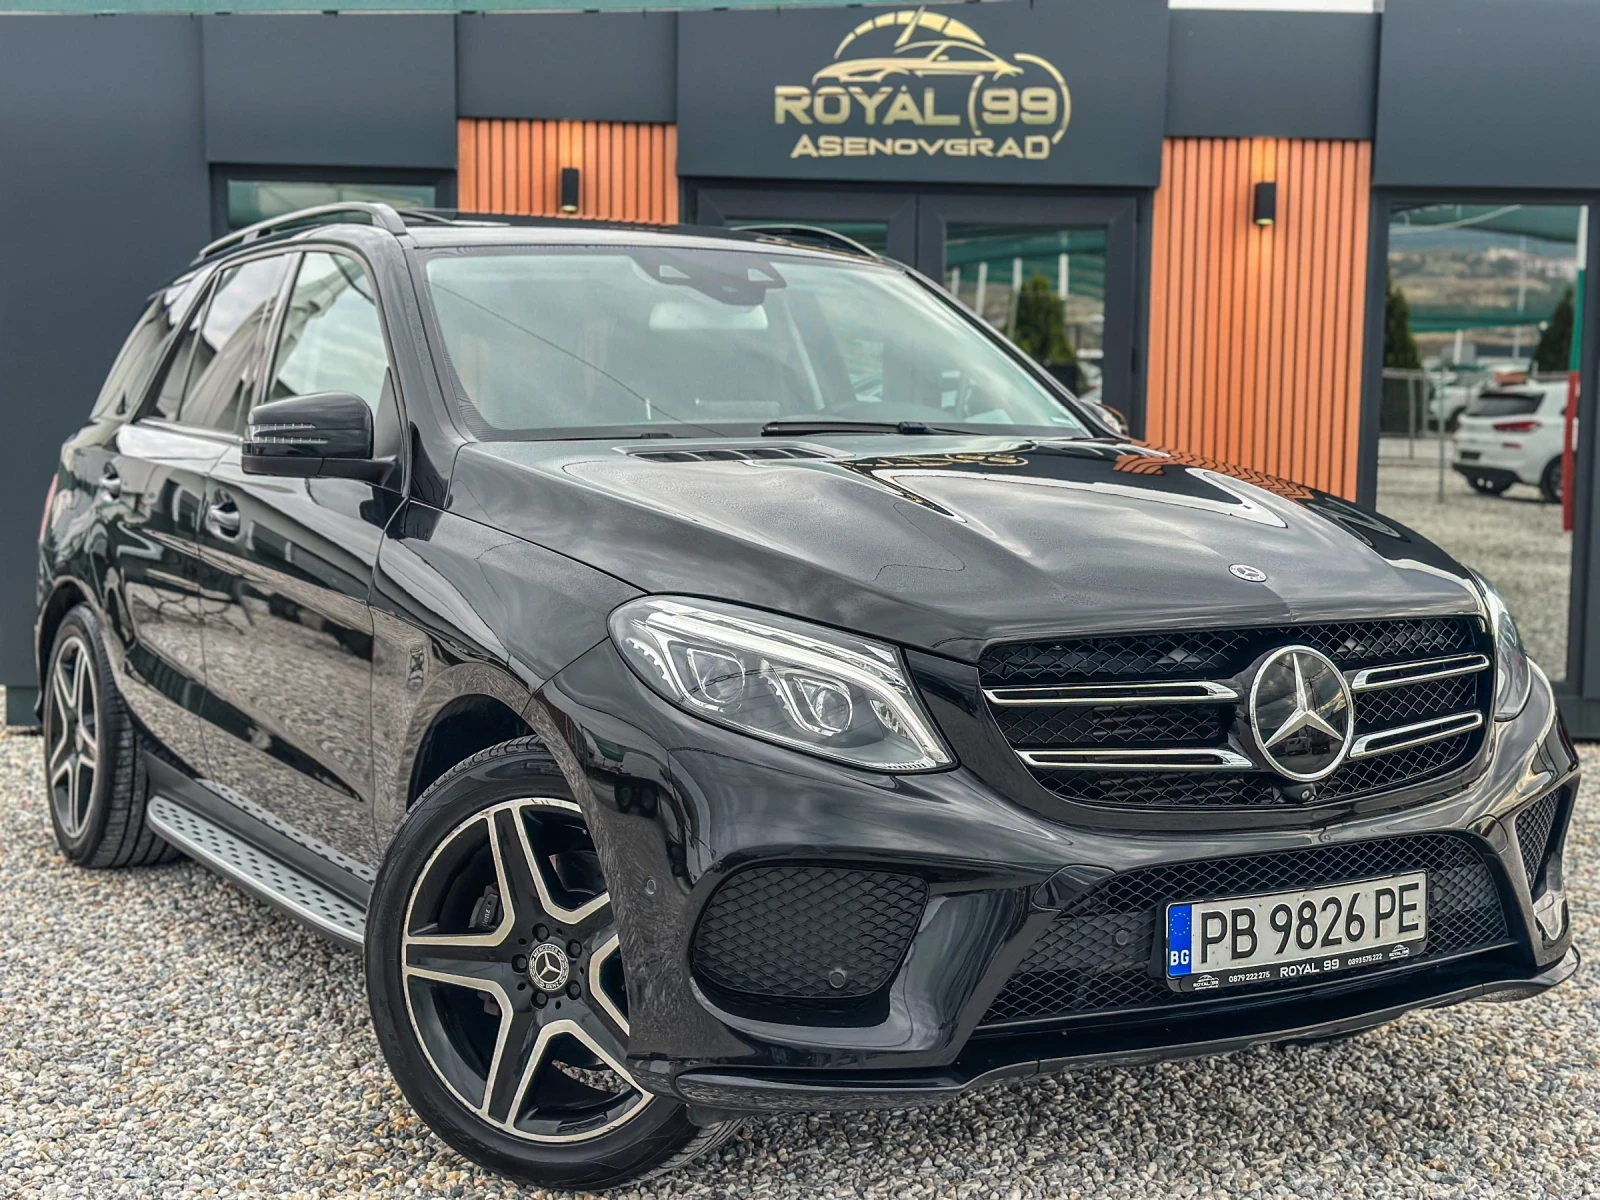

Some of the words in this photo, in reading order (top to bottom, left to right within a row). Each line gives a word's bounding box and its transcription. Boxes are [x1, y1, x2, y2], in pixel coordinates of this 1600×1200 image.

[774, 85, 960, 125] ROYAL
[981, 87, 1057, 125] 99
[790, 133, 1050, 160] ASENOVGRAD
[1200, 907, 1258, 963] PB
[1269, 892, 1365, 955] 9826
[1374, 882, 1419, 939] PE
[1170, 949, 1190, 966] BG
[1280, 961, 1320, 978] ROYAL
[1323, 958, 1339, 971] 99
